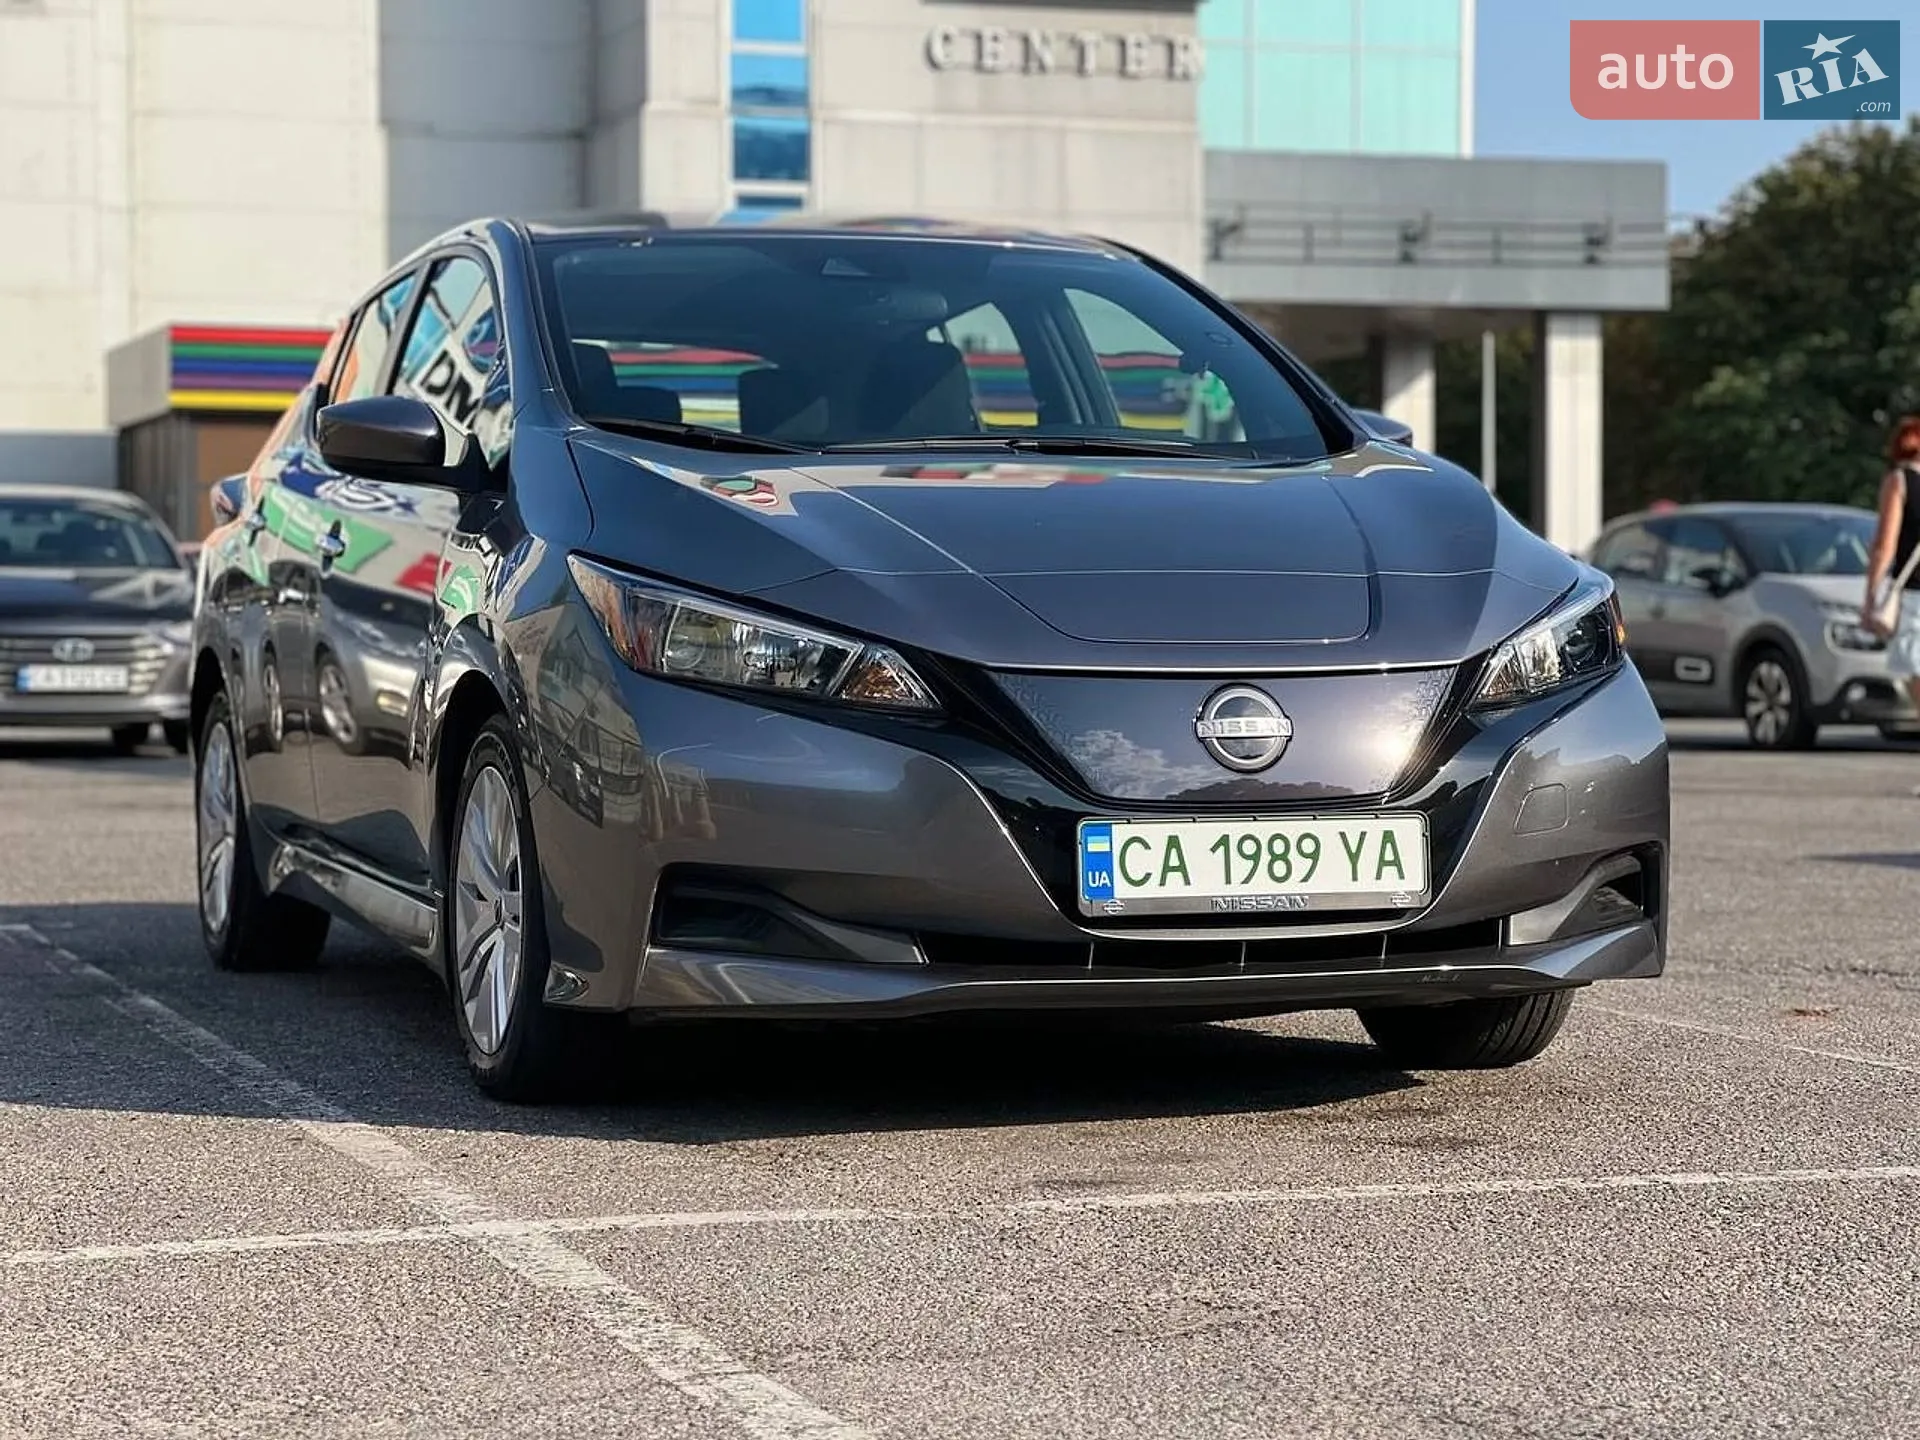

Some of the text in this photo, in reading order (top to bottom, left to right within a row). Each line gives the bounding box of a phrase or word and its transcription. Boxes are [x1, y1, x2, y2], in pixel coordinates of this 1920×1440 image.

[923, 25, 1207, 81] CENTER
[1199, 720, 1291, 736] NISSAN
[1119, 829, 1406, 888] CA 1989 YA
[1088, 871, 1112, 888] UA
[1210, 895, 1310, 912] NISSAN
